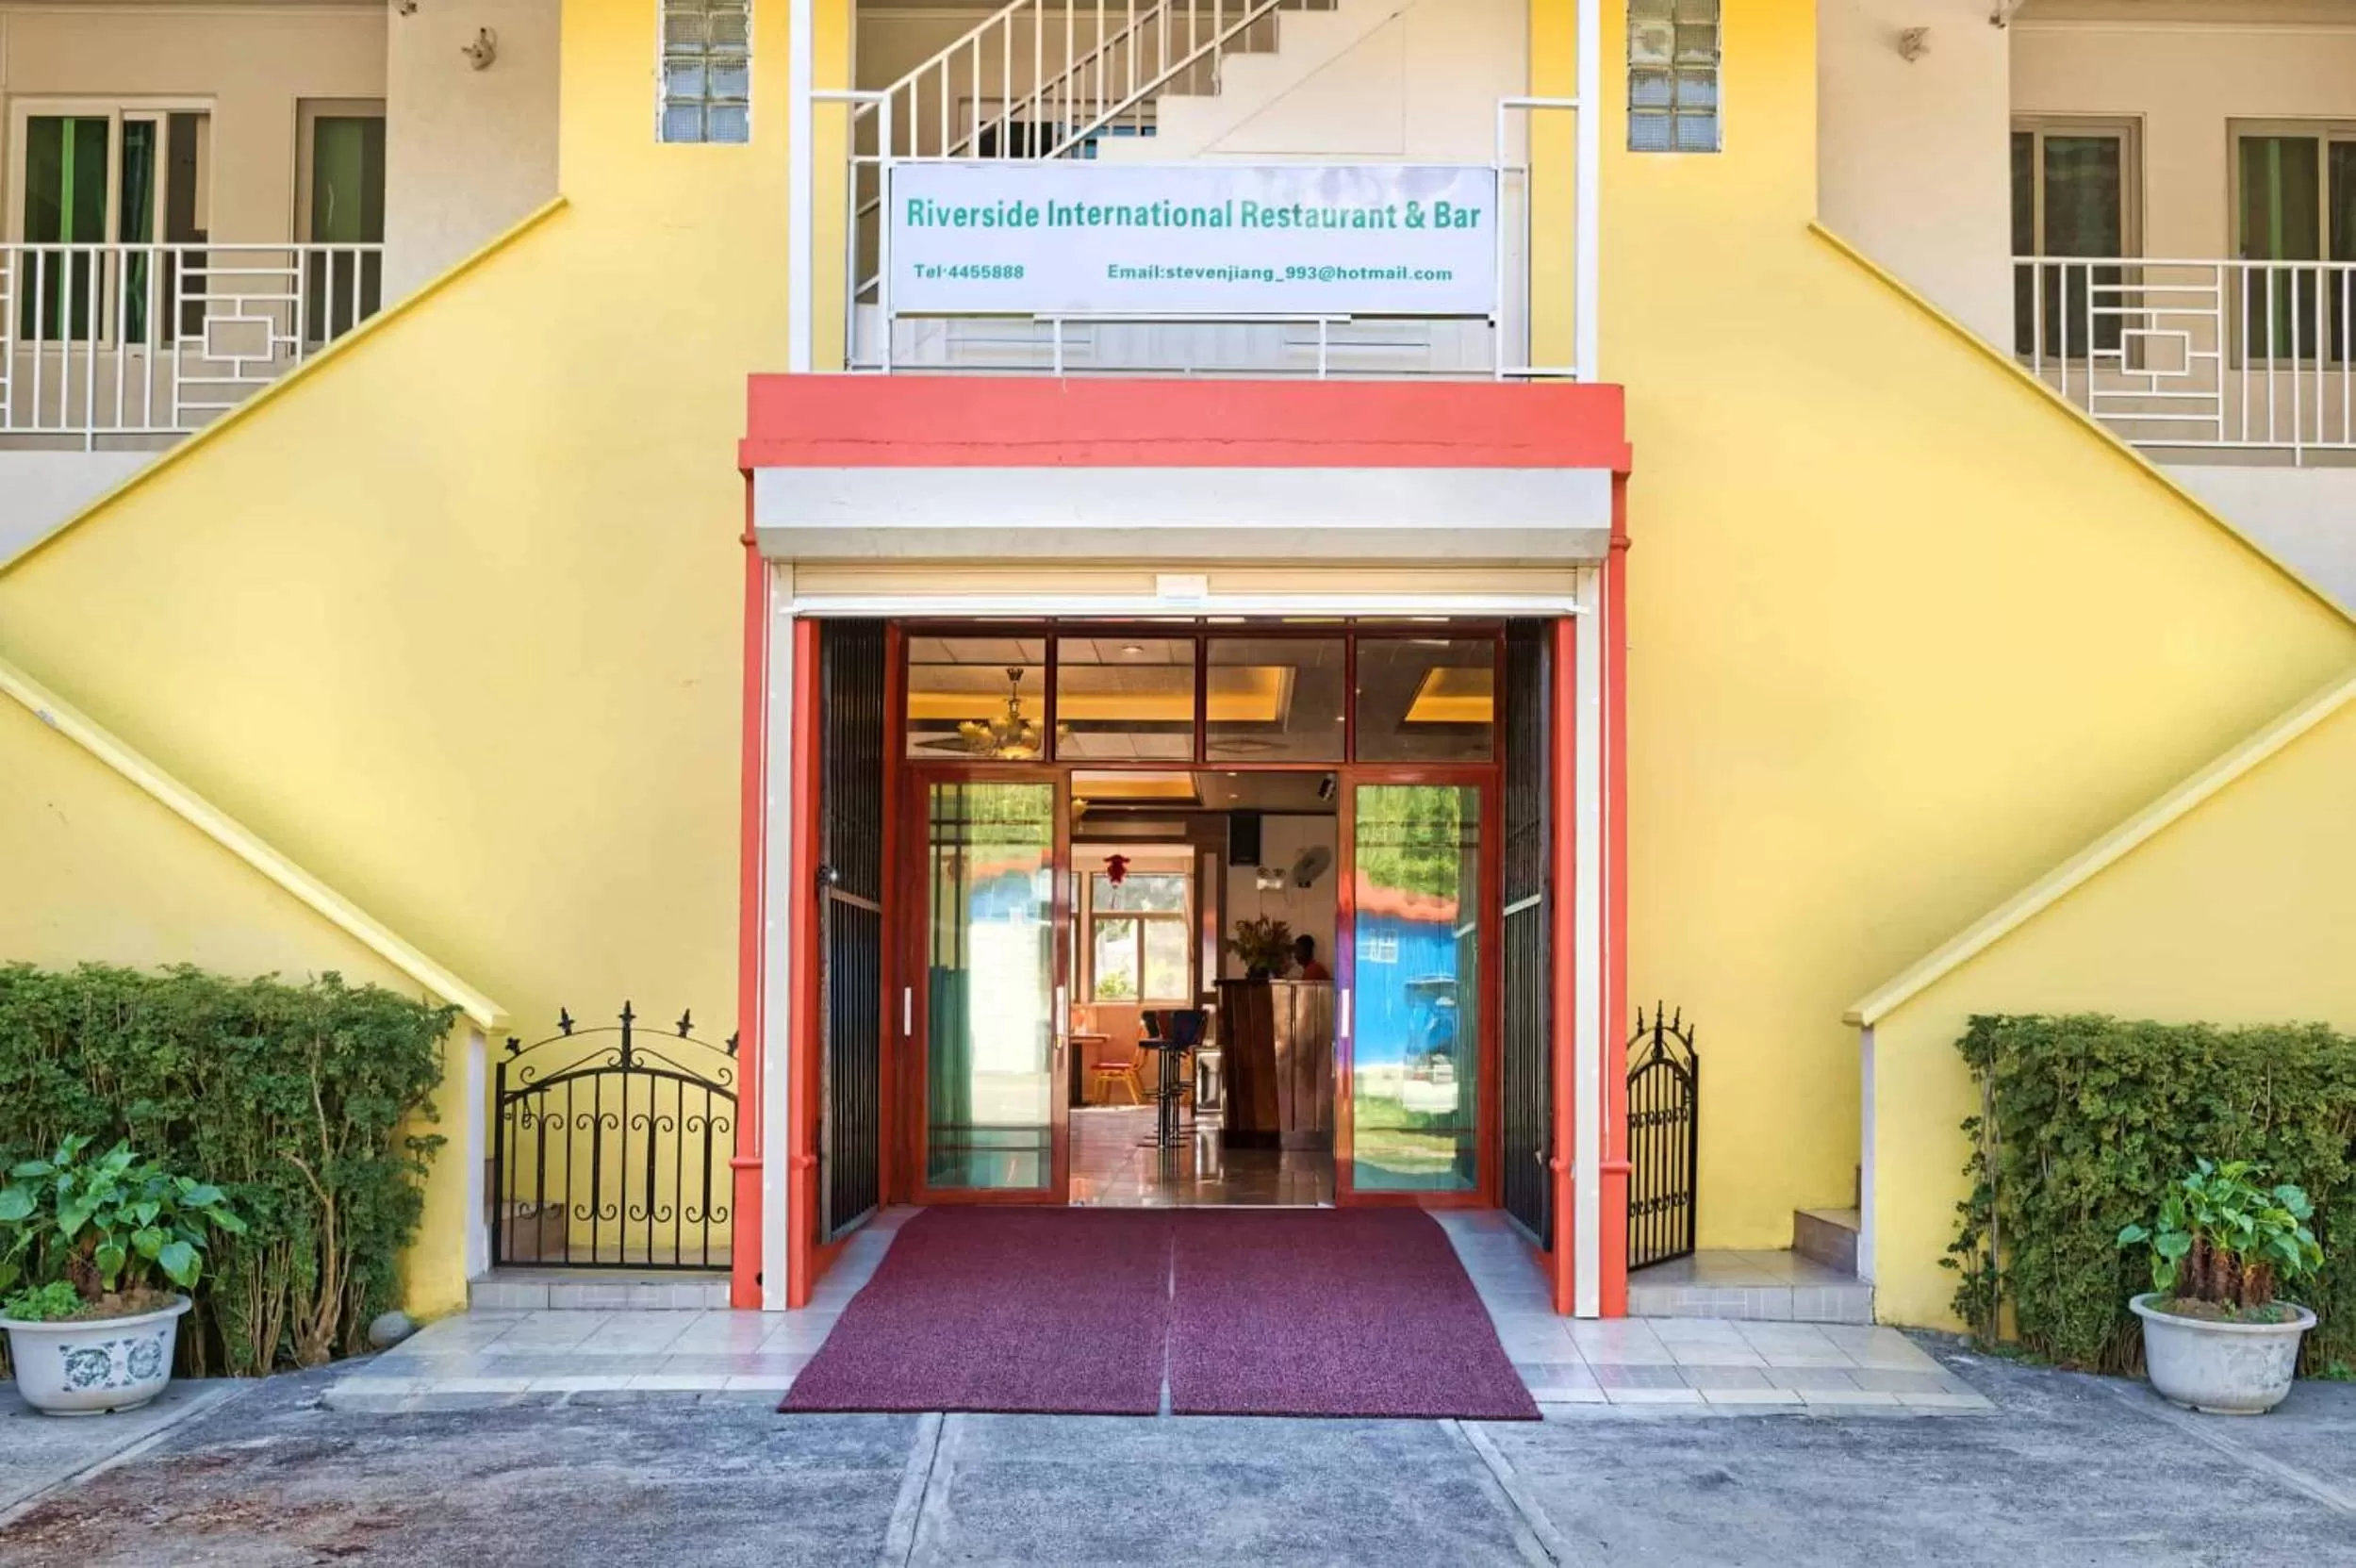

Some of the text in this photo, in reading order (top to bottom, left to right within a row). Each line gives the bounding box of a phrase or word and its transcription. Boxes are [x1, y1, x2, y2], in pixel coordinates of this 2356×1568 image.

[906, 198, 1482, 229] Riverside International Restaurant & Bar
[1107, 264, 1453, 283] Email:stevenjiang_993@hotmail.com
